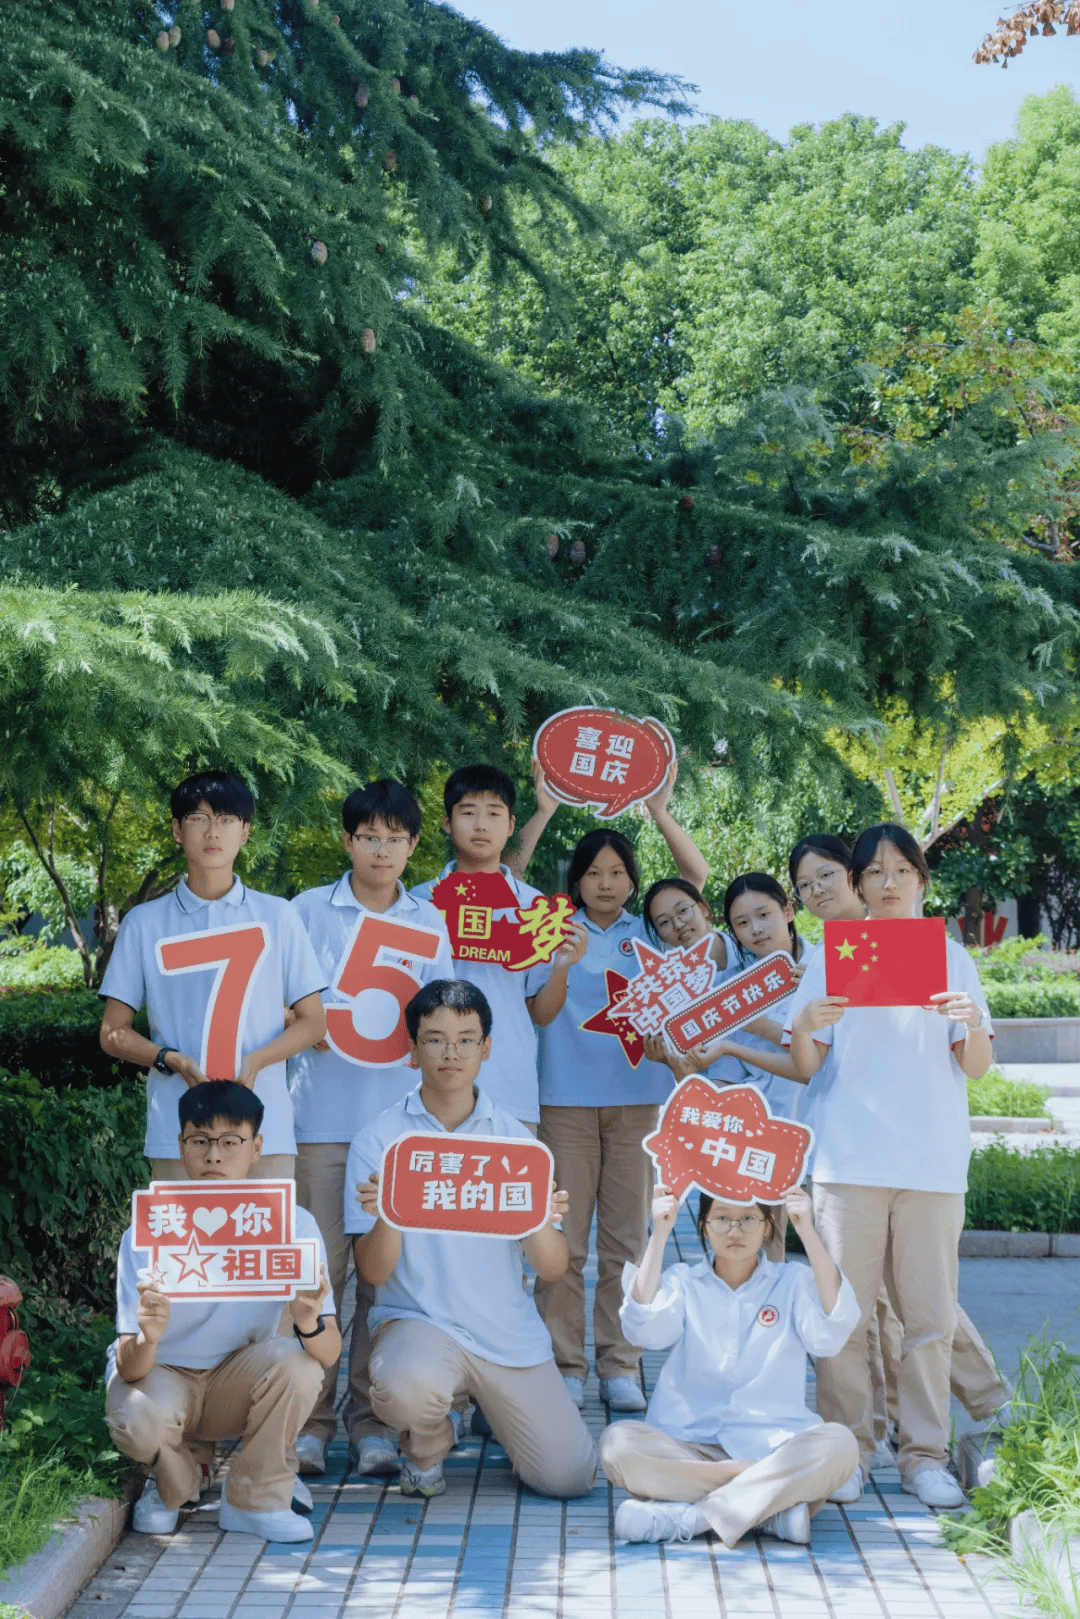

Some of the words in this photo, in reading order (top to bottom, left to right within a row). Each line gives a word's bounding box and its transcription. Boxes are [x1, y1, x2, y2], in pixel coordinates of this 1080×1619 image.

[574, 726, 635, 760] 喜迎
[569, 752, 630, 785] 国庆
[440, 897, 574, 969] 国梦
[459, 945, 511, 962] DREAM
[681, 969, 785, 1041] 国庆节快乐
[680, 1106, 745, 1134] 我爱你
[409, 1150, 491, 1177] 厉害了
[700, 1136, 777, 1183] 中国
[421, 1178, 534, 1212] 我的国
[221, 1247, 302, 1282] 祖国
